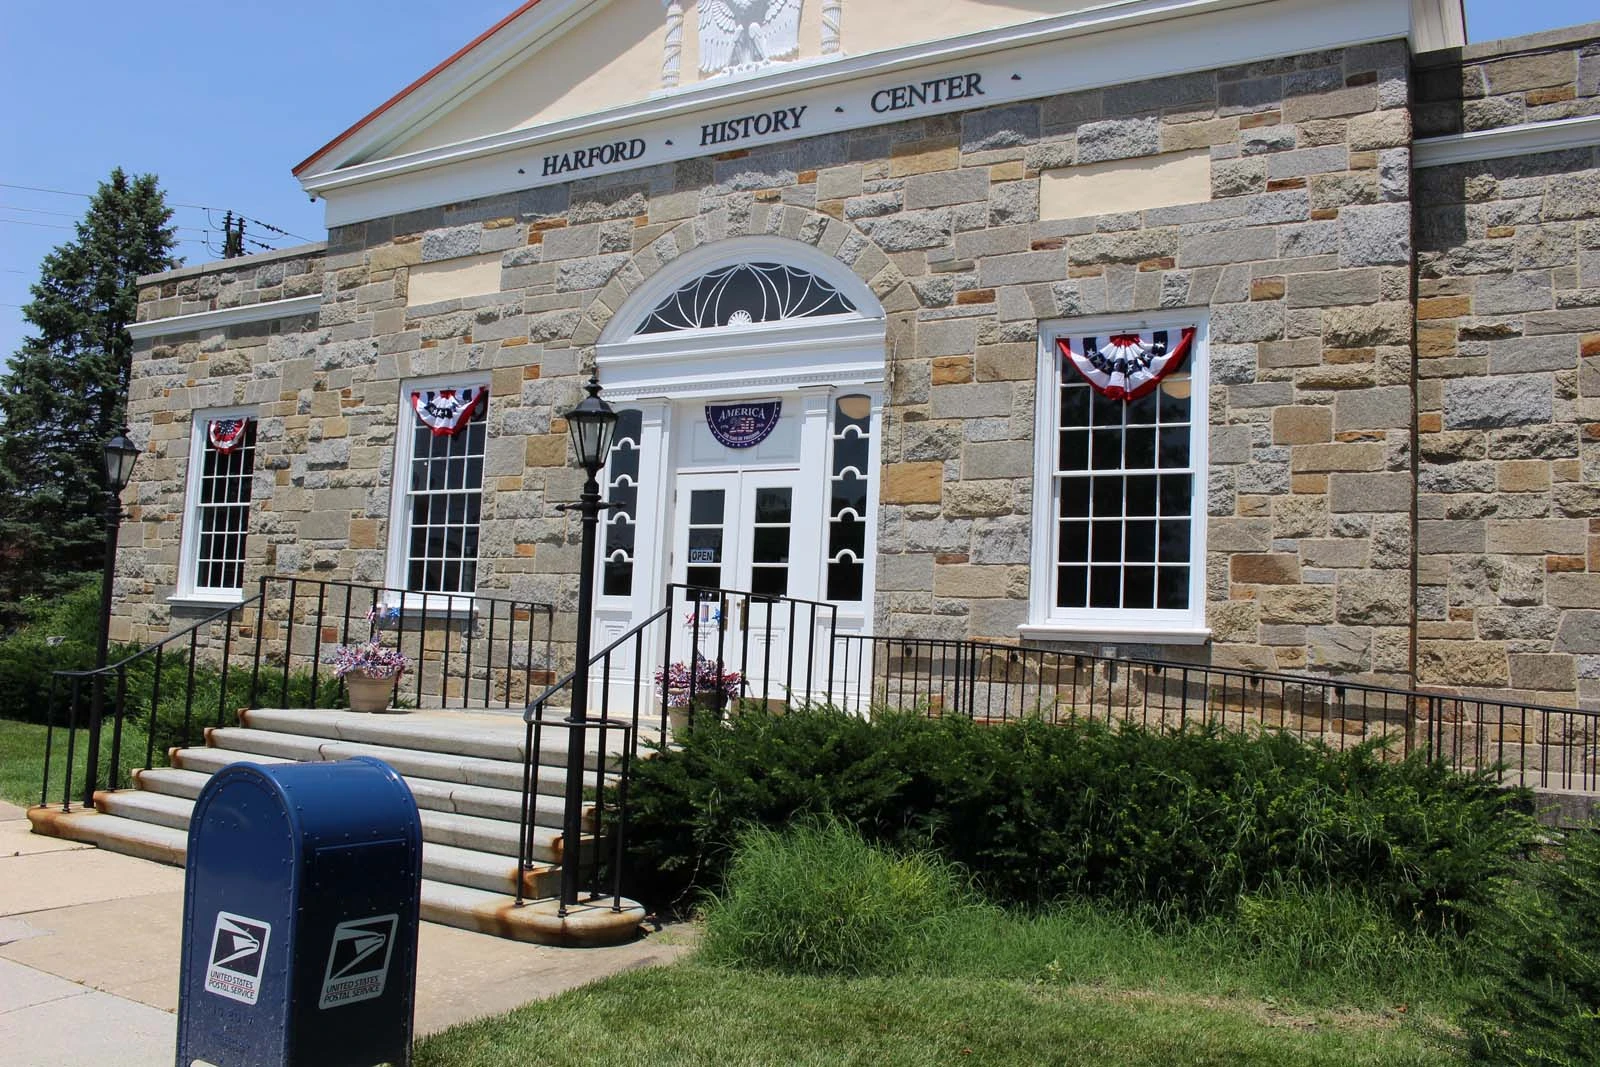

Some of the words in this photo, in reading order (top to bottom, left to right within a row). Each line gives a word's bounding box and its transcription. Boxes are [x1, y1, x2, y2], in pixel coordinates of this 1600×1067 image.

[541, 138, 646, 176] HARFORD
[699, 105, 808, 146] HISTORY
[870, 72, 985, 113] CENTER
[718, 407, 766, 422] AMERICA
[692, 551, 713, 561] OPEN
[210, 970, 233, 983] UNITED
[233, 976, 254, 989] STATES
[326, 981, 353, 993] UNITED
[355, 975, 378, 987] STATES
[208, 980, 230, 993] POSTAL
[230, 985, 255, 1000] SERVICE
[324, 990, 350, 1004] POSTAL
[352, 985, 380, 998] SERVICE
